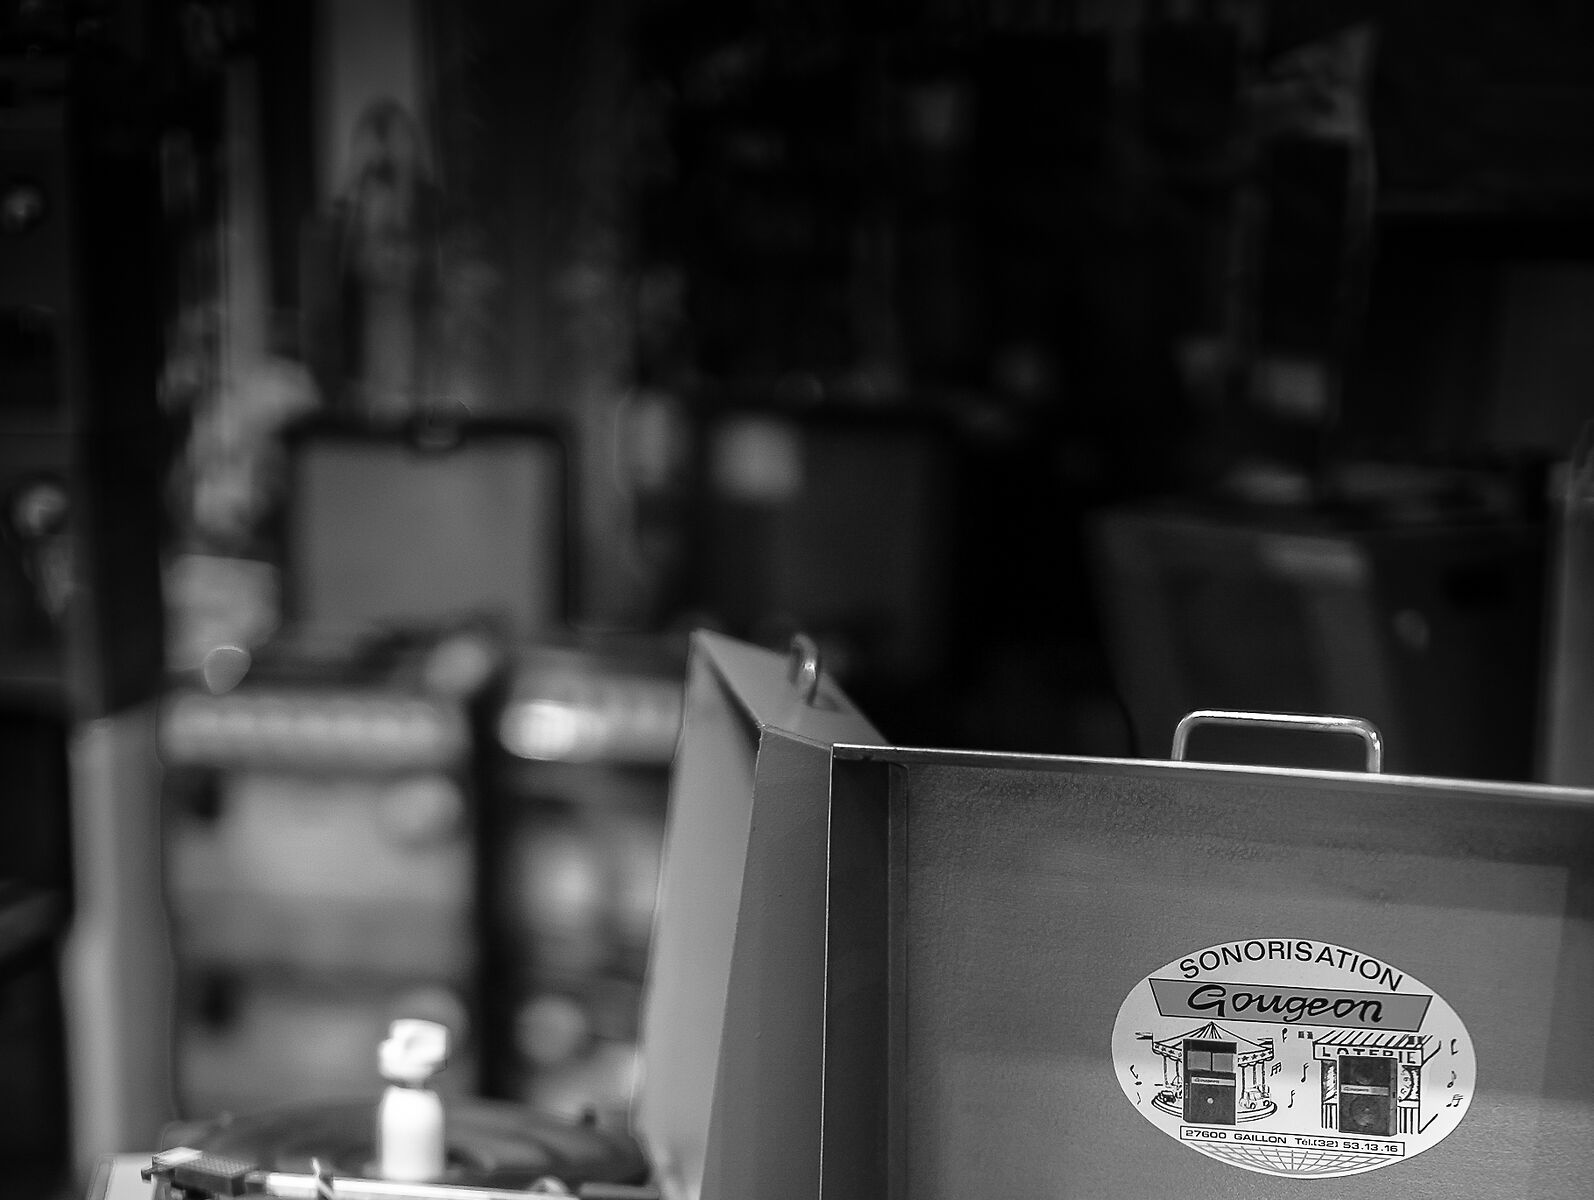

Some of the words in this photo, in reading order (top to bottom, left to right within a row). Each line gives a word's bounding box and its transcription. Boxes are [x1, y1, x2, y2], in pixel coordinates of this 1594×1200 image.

[1179, 940, 1403, 991] SONORISATION
[1187, 984, 1383, 1023] Gougeon
[1185, 1129, 1227, 1140] 27600
[1233, 1132, 1287, 1144] GAILLON
[1342, 1141, 1399, 1153] 53.13.16
